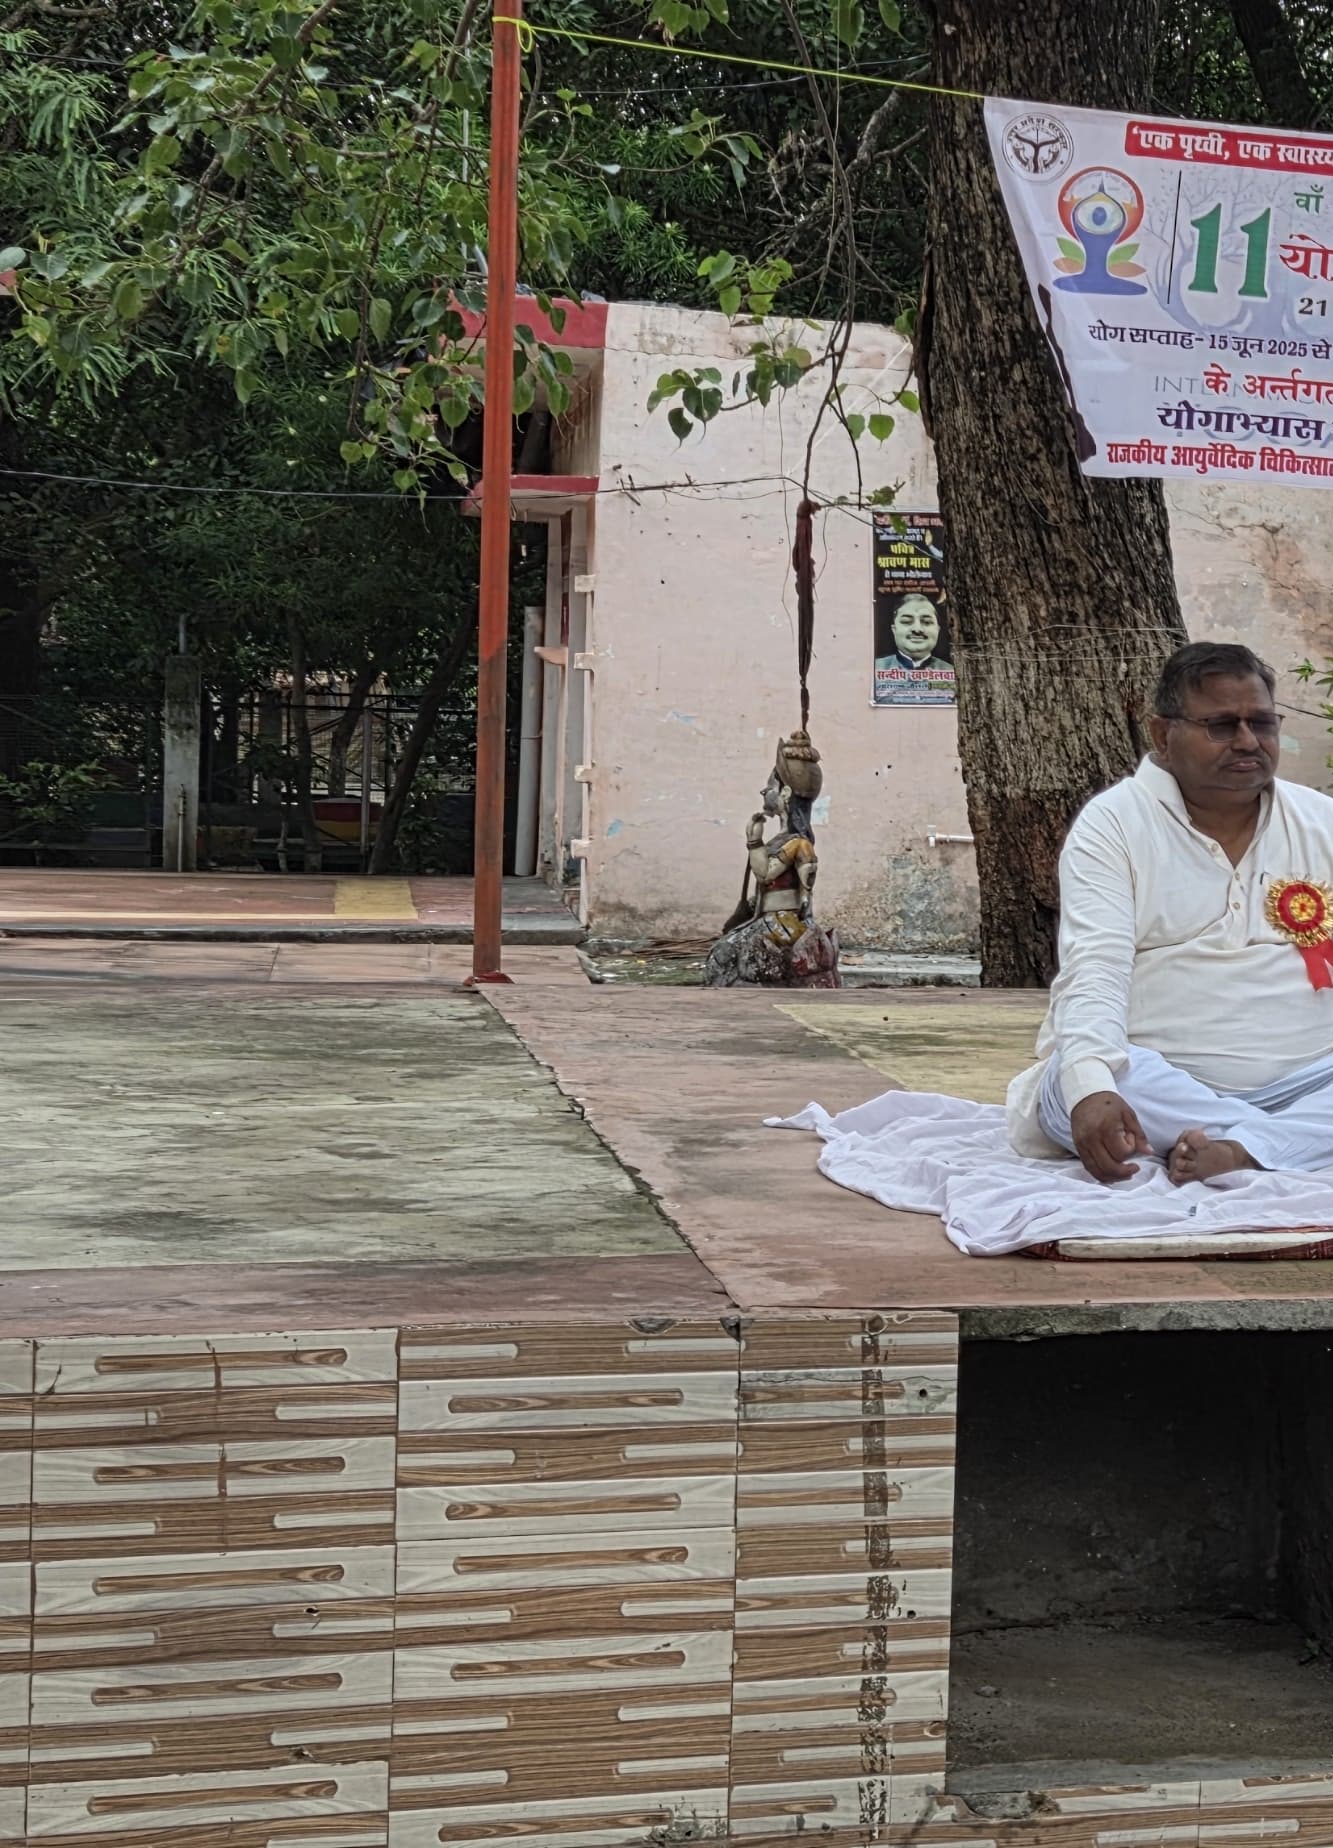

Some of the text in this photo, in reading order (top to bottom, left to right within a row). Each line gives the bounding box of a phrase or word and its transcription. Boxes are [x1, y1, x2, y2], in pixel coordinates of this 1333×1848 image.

[1180, 131, 1230, 160] पृथ्वी,
[1237, 140, 1273, 160] एक
[1293, 184, 1324, 214] वाँ
[1187, 202, 1271, 298] 11
[1298, 297, 1327, 316] 21
[1088, 320, 1126, 342] योग
[1209, 334, 1228, 350] 15
[1231, 336, 1264, 358] जून
[1268, 339, 1307, 357] 2025
[1312, 339, 1332, 360] से
[1203, 363, 1231, 395] के
[1156, 400, 1325, 441] योगाभ्यास
[1107, 439, 1167, 465] राजकीय
[1171, 442, 1256, 474] आयुर्वेदिक
[909, 556, 931, 568] मास
